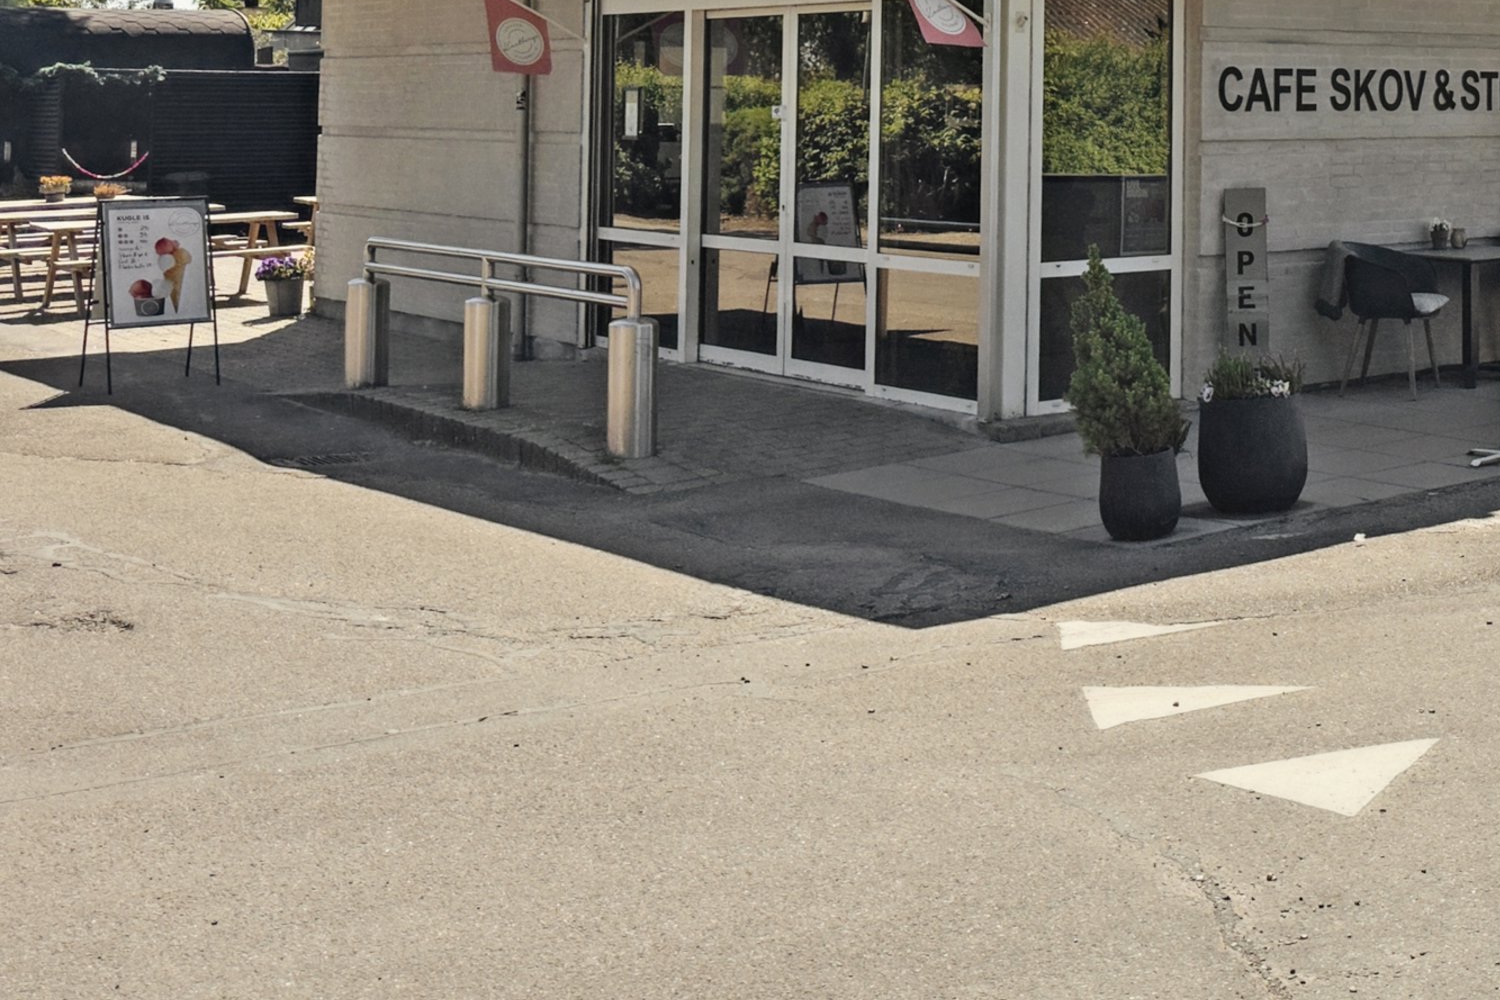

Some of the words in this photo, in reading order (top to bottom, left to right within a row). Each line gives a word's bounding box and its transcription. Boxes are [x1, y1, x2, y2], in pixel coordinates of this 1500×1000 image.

[1218, 66, 1318, 113] CAFE
[1329, 68, 1427, 112] SKOV
[1433, 68, 1457, 112] &
[1236, 211, 1257, 347] OPEN
